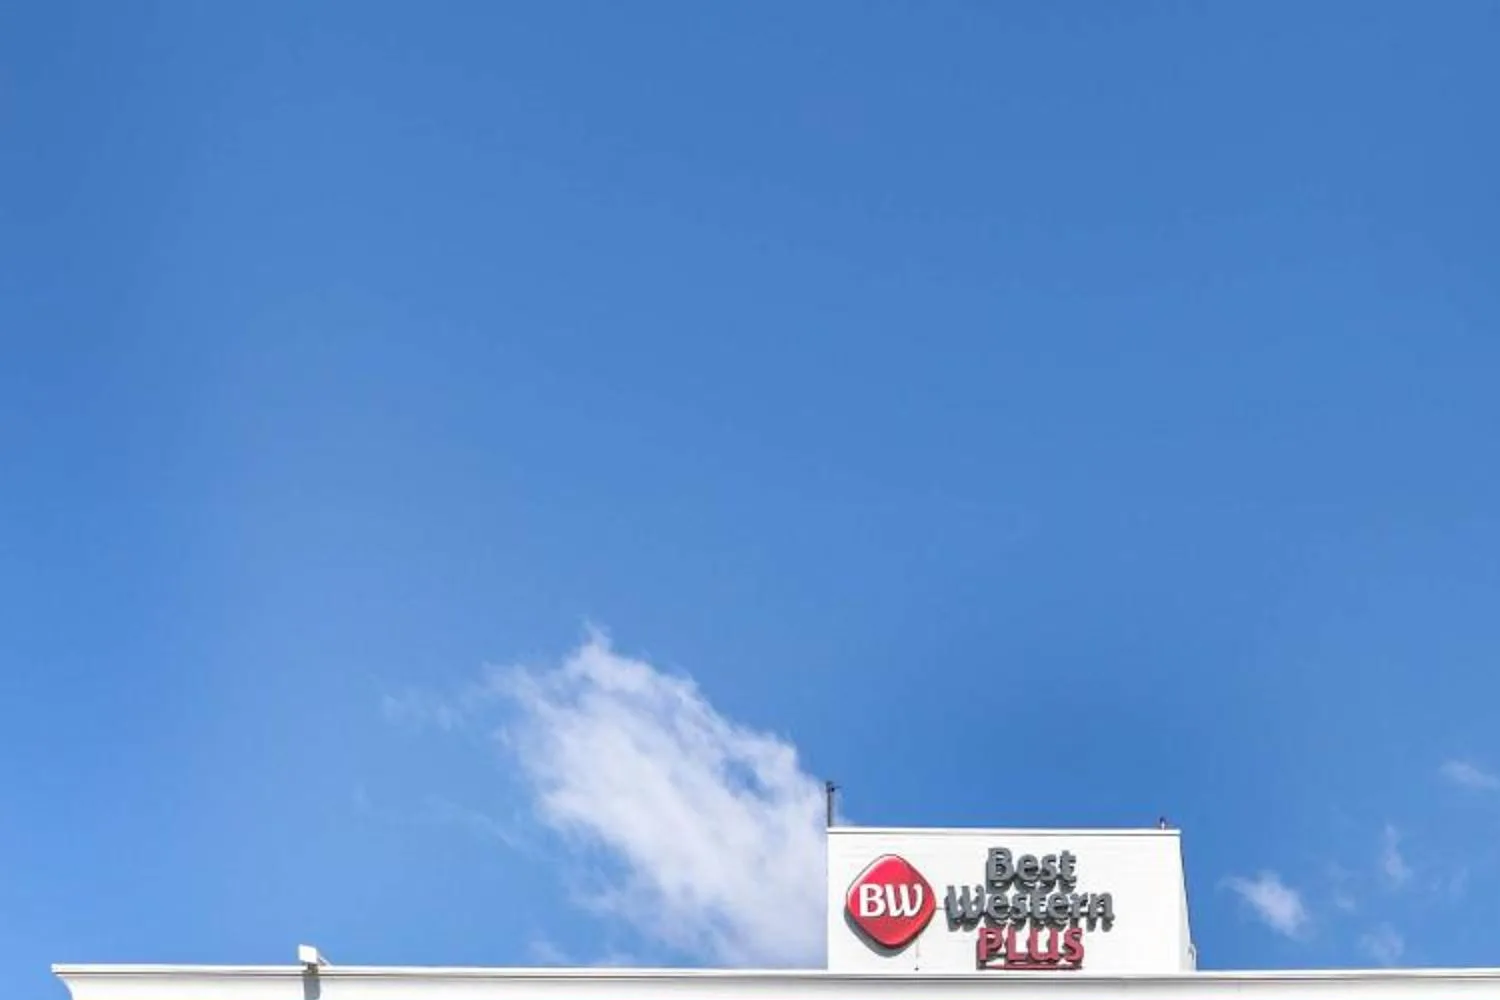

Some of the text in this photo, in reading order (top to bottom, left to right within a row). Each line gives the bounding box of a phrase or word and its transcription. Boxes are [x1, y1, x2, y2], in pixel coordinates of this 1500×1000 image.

[987, 847, 1077, 883] Best
[859, 883, 924, 917] BW
[945, 884, 1115, 921] Western
[977, 927, 1085, 962] PLUS
